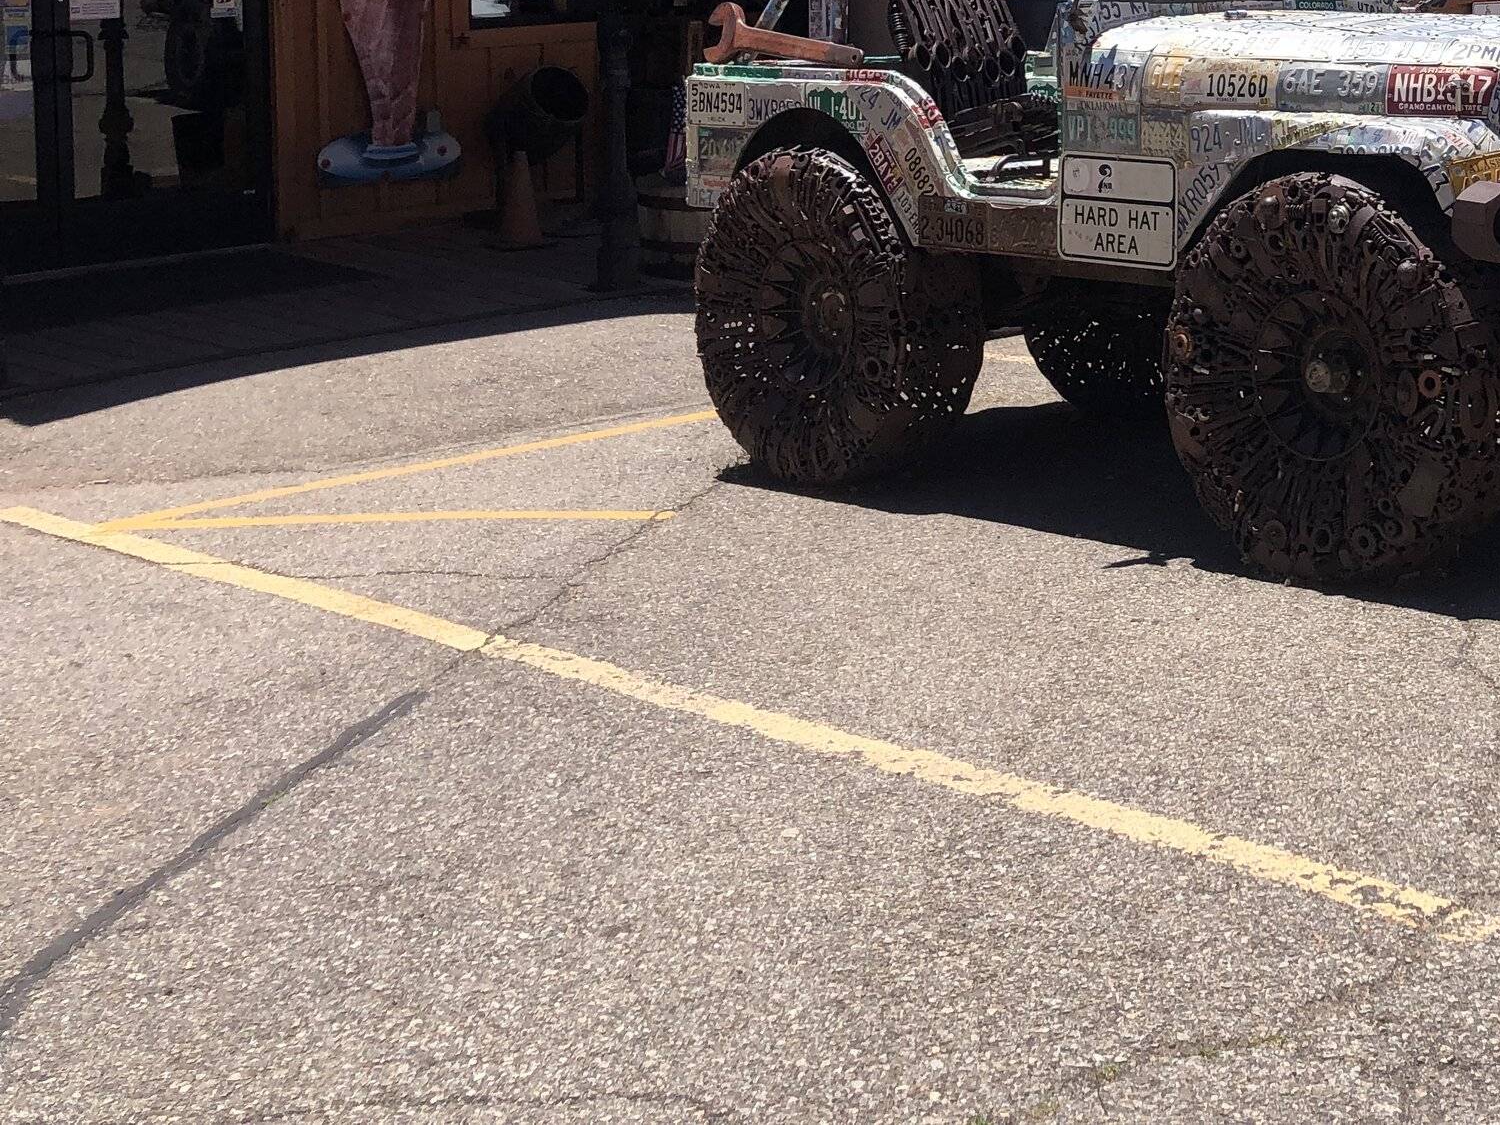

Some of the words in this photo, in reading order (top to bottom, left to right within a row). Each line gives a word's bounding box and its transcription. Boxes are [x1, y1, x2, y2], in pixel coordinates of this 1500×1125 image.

[1299, 1, 1335, 10] COLORADO
[1357, 1, 1383, 14] UTAH
[1085, 91, 1113, 100] FAYETTE
[1393, 73, 1437, 104] NHB
[1398, 103, 1425, 111] GRAND
[1191, 122, 1222, 153] 924
[1074, 205, 1119, 227] HARD
[1128, 209, 1160, 231] HAT
[1094, 233, 1139, 256] AREA
